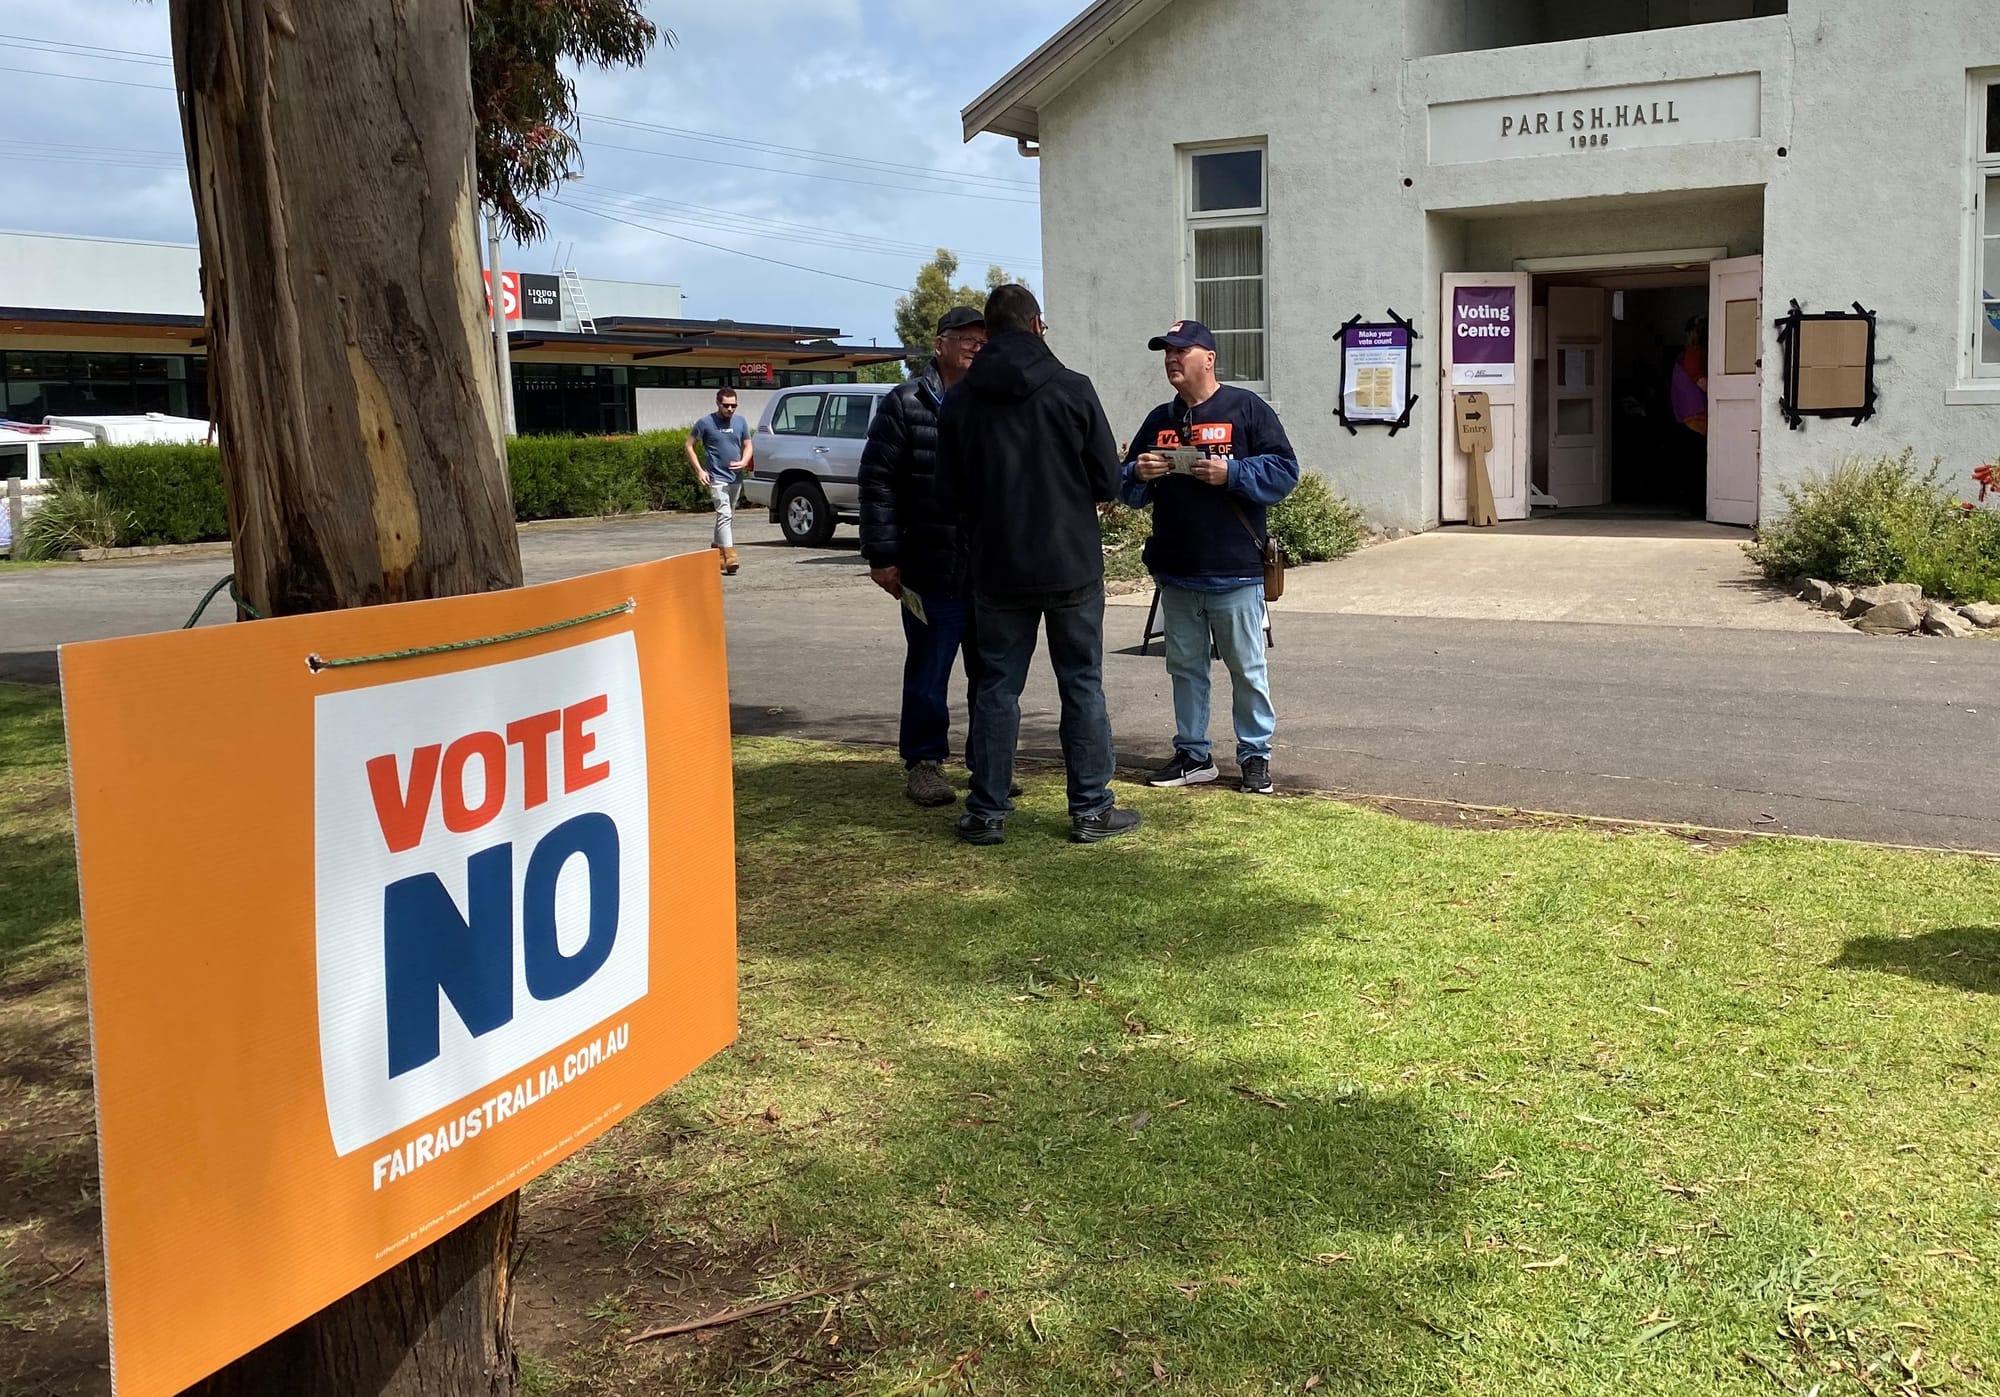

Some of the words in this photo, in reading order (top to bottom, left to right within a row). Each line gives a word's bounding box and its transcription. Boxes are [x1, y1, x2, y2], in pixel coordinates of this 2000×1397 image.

[527, 288, 557, 298] LIQUOR
[533, 297, 554, 305] LAND
[1457, 305, 1510, 321] Voting
[1457, 323, 1510, 337] Centre
[740, 363, 768, 374] coles
[1202, 427, 1226, 440] NO
[1463, 424, 1488, 434] Entry
[1219, 444, 1232, 454] OF
[366, 694, 610, 854] VOTE
[384, 812, 620, 1080] NO
[373, 1023, 629, 1191] FAIRAUSTRALIA.COM.AU
